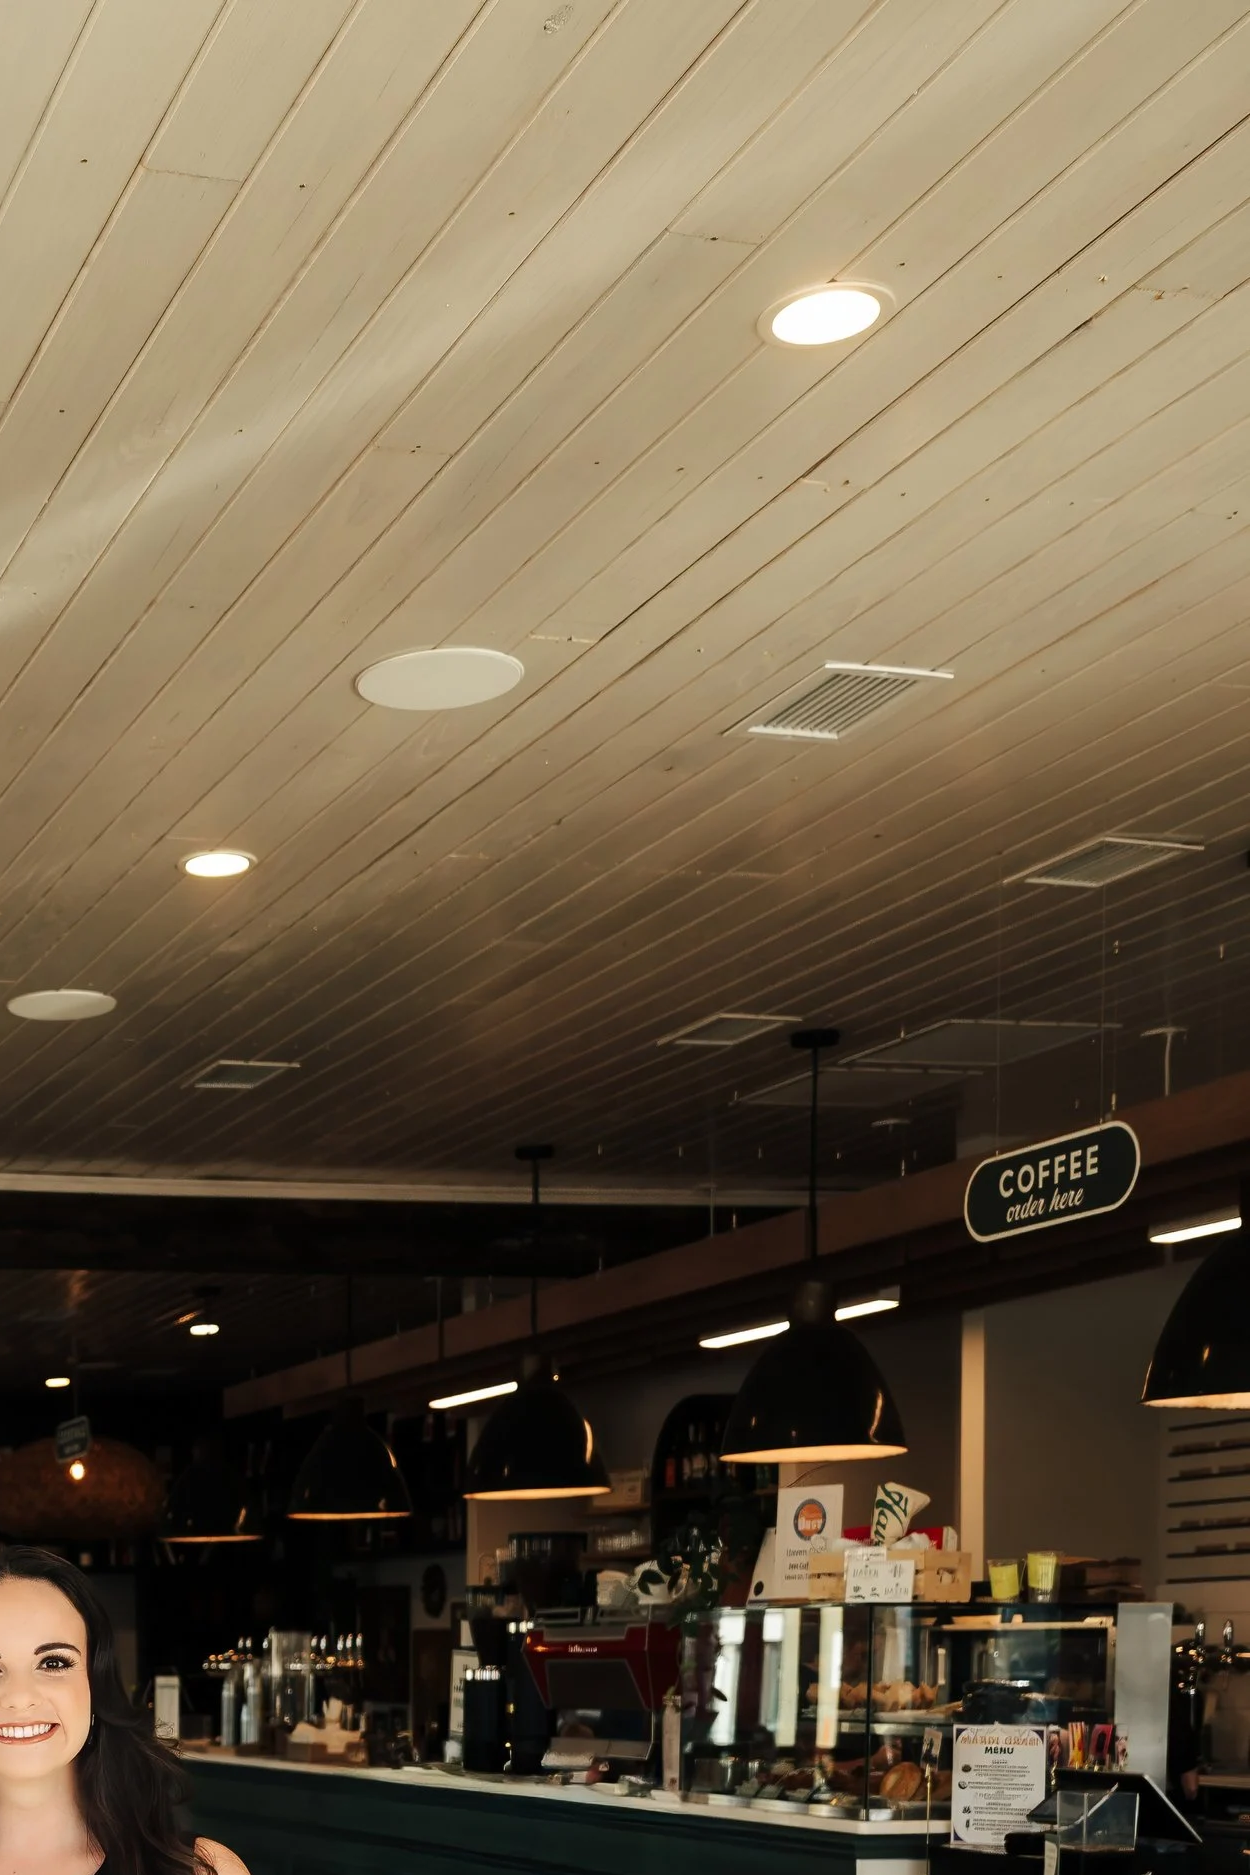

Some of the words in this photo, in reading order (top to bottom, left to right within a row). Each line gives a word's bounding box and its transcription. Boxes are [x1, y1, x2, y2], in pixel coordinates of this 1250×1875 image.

[998, 1144, 1099, 1199] COFFEE
[1005, 1194, 1046, 1224] order
[1048, 1187, 1085, 1214] here
[984, 1746, 1015, 1755] MENU
